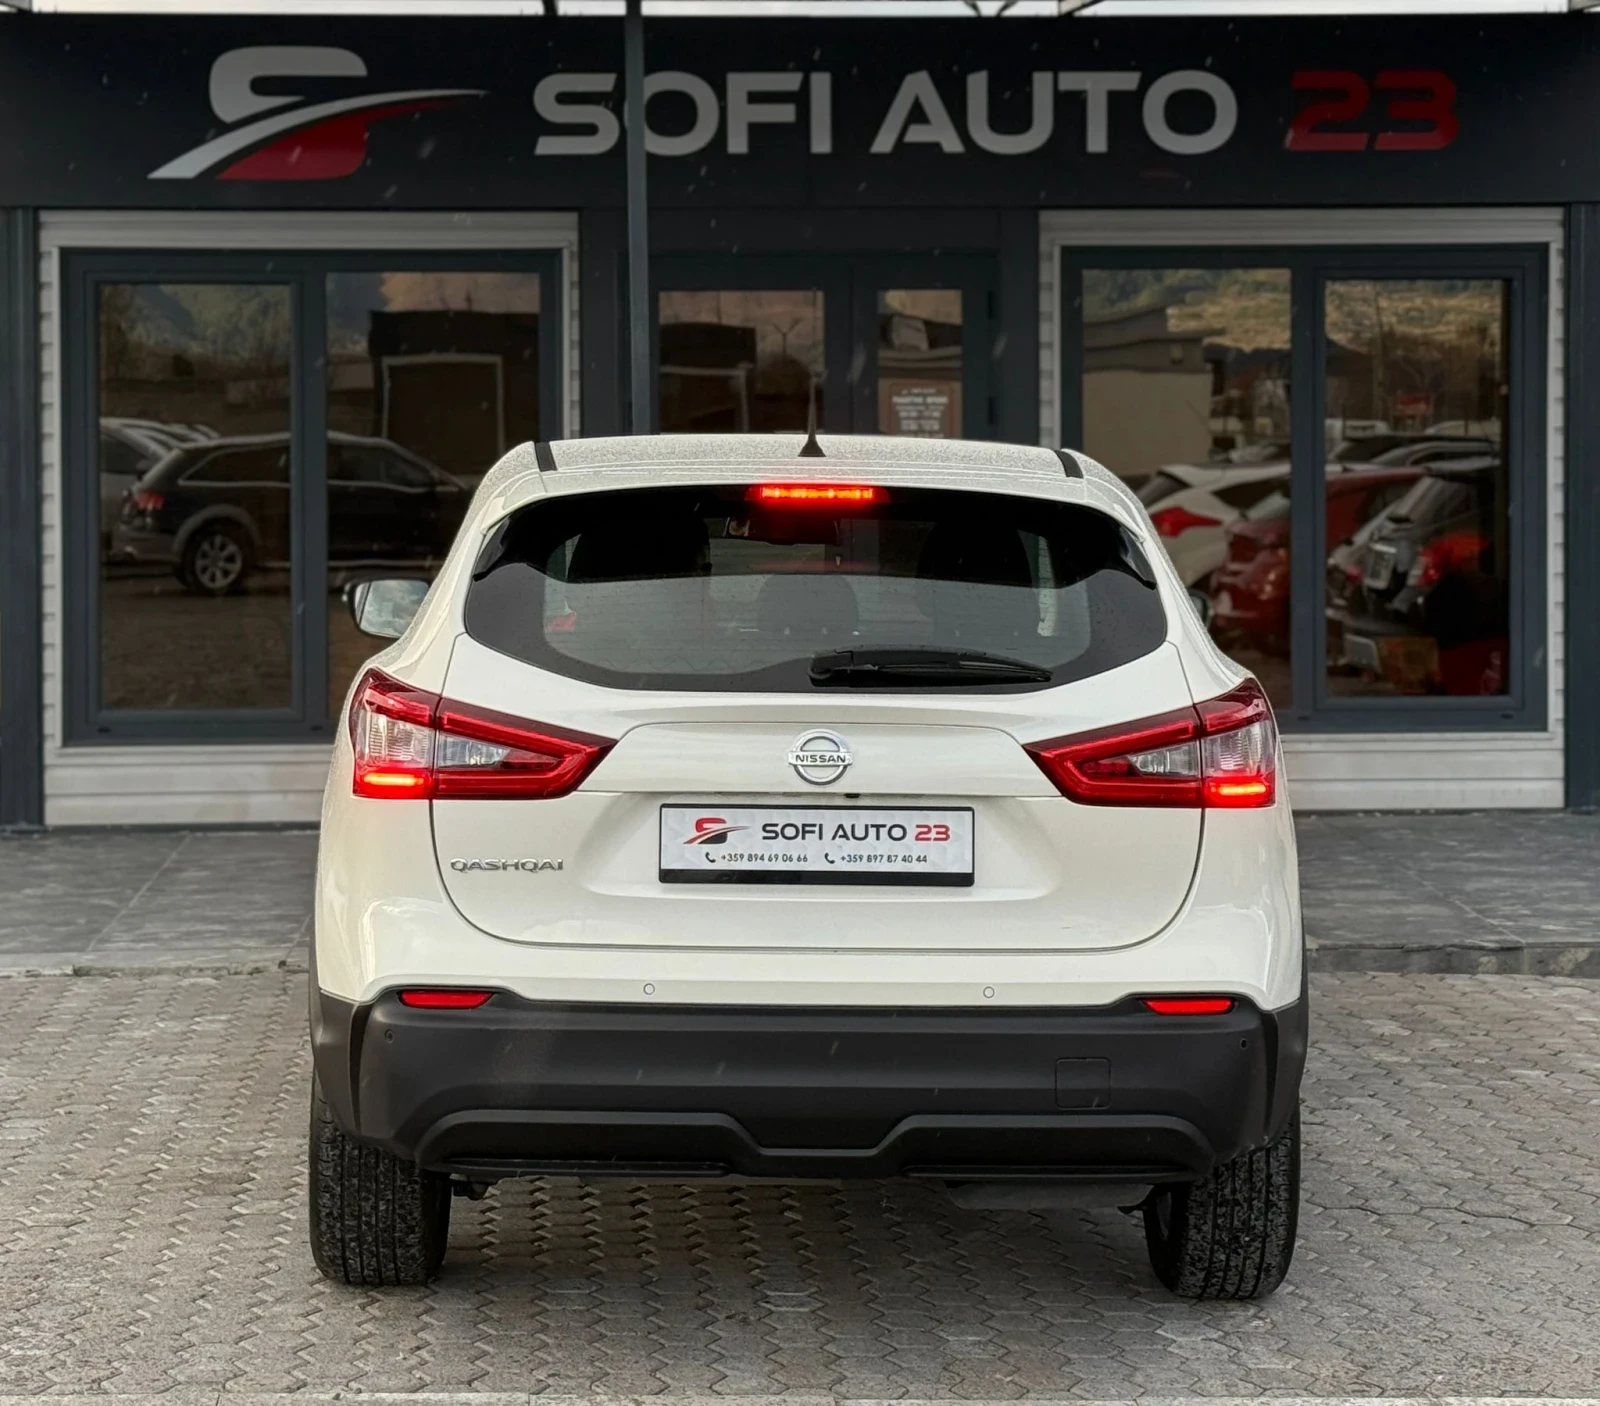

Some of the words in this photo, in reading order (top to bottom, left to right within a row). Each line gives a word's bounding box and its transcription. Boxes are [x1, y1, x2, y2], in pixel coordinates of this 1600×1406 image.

[533, 71, 832, 157] SOFI
[870, 70, 1238, 155] AUTO
[1285, 69, 1459, 151] 23
[795, 754, 846, 764] NISSAN
[761, 822, 824, 841] SOFI
[831, 823, 908, 842] AUTO
[914, 823, 951, 843] 23
[720, 852, 745, 863] +359
[746, 852, 766, 863] 894
[767, 853, 780, 863] 69
[781, 853, 794, 863] 06
[796, 853, 809, 863] 66
[840, 853, 864, 864] +359
[866, 853, 885, 864] 897
[886, 854, 899, 864] 87
[900, 854, 914, 864] 40
[915, 854, 928, 864] 44
[450, 857, 564, 874] QASHQAI
